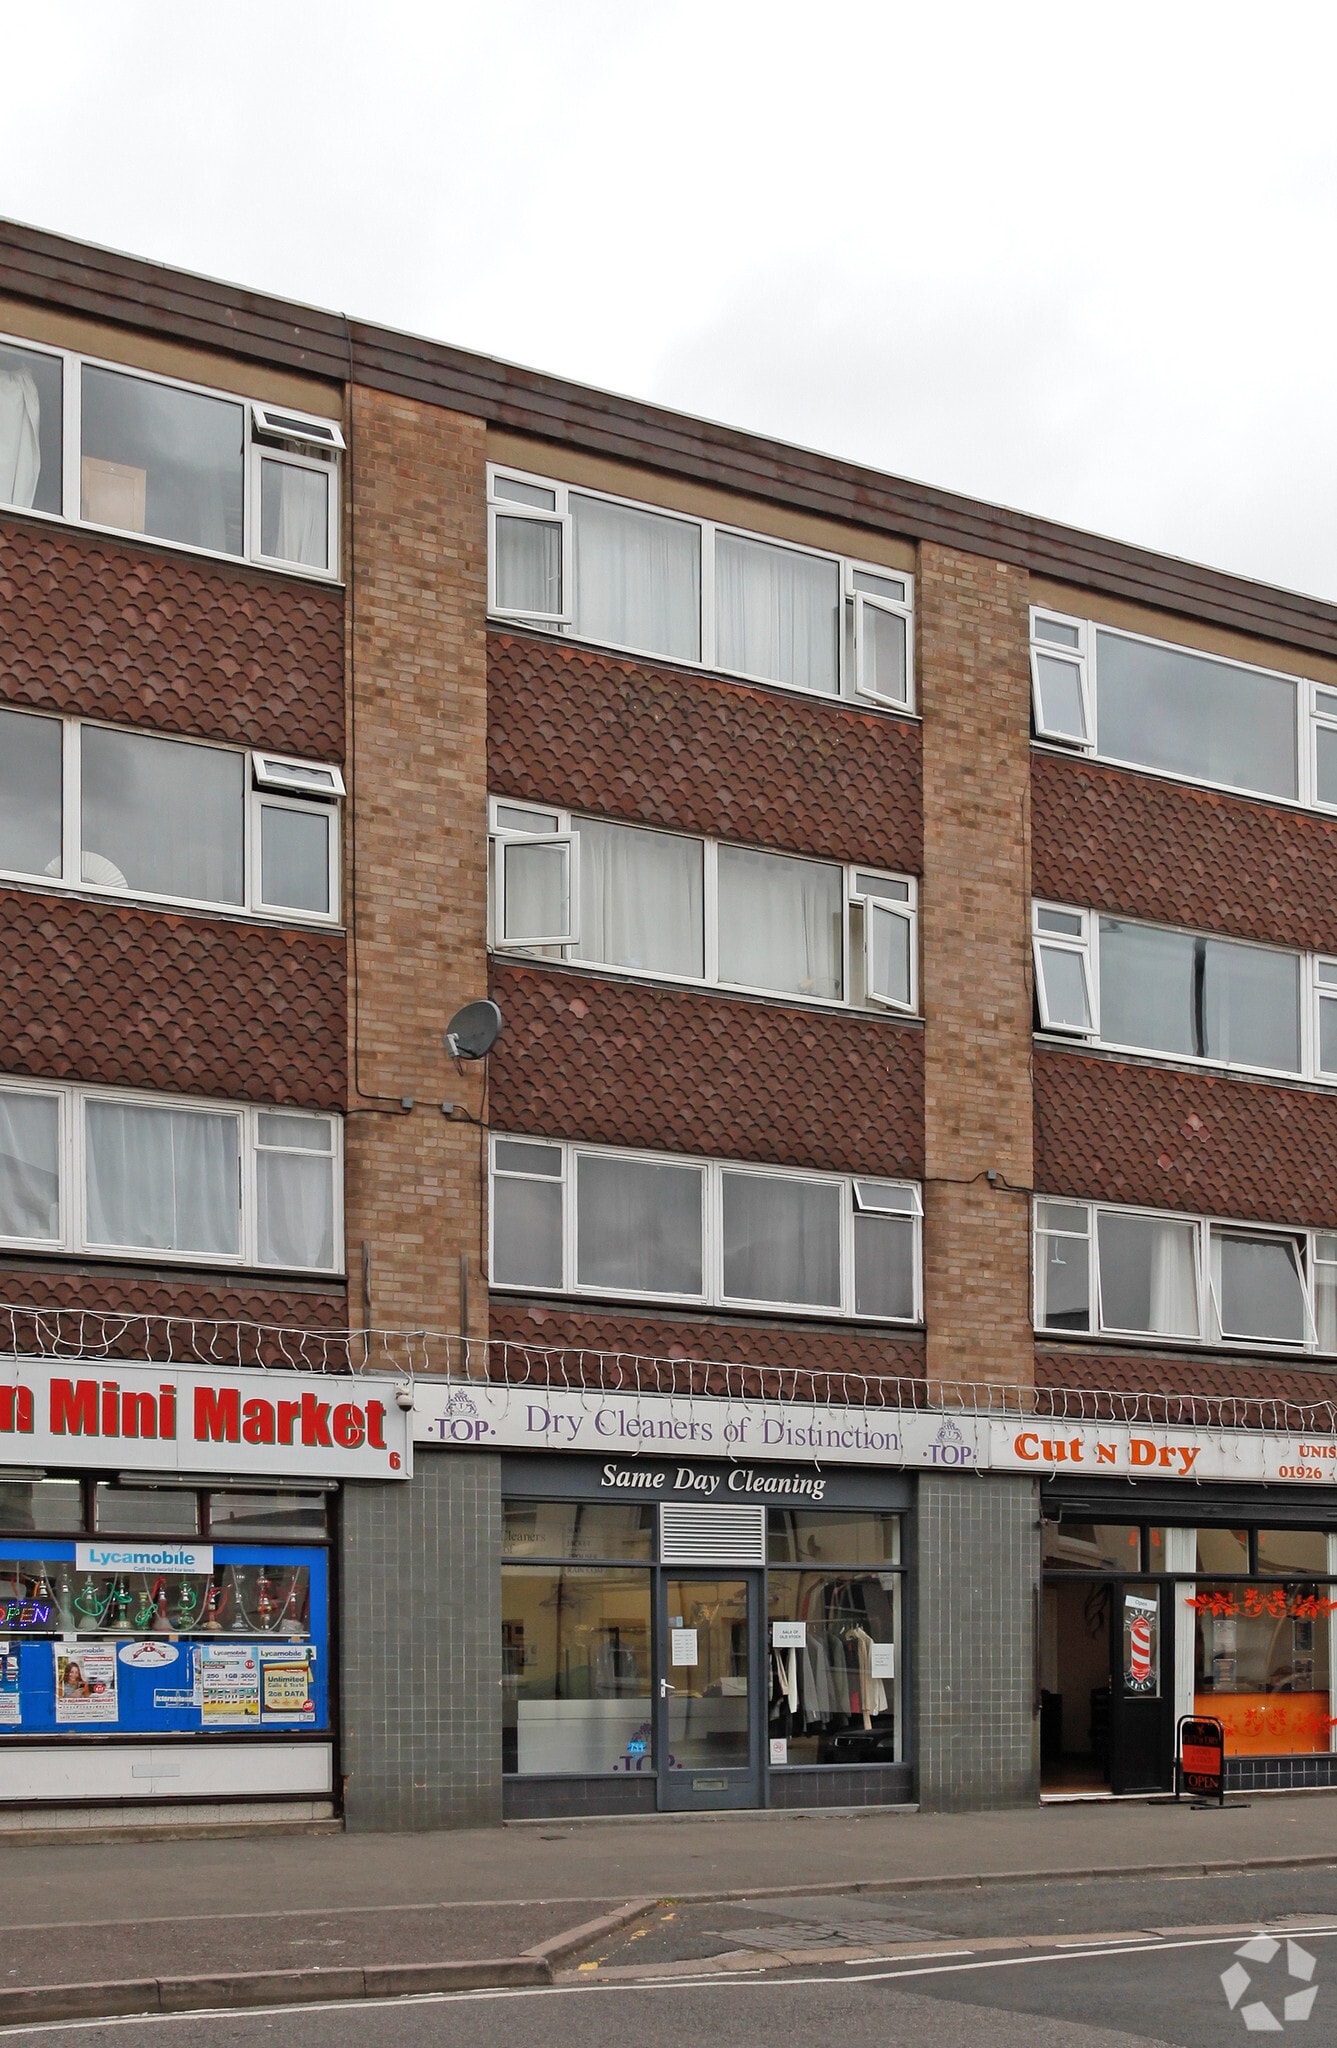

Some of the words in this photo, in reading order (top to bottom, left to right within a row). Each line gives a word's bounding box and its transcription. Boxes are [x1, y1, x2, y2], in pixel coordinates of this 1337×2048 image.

[50, 1378, 177, 1440] Mini
[194, 1386, 388, 1450] Market
[434, 1417, 490, 1441] TOP
[525, 1405, 584, 1442] Dry
[594, 1409, 713, 1442] Cleaners
[723, 1417, 751, 1443] of
[762, 1418, 900, 1451] Distinction
[389, 1451, 401, 1470] 6
[928, 1444, 972, 1465] TOP
[1014, 1433, 1084, 1462] Cut
[1129, 1439, 1201, 1475] Dry
[601, 1463, 666, 1488] Same
[673, 1467, 720, 1495] Day
[727, 1469, 826, 1500] Cleaning
[1278, 1465, 1323, 1479] 01926
[89, 1549, 195, 1566] Lycamobile
[1188, 1774, 1219, 1789] OPEN
